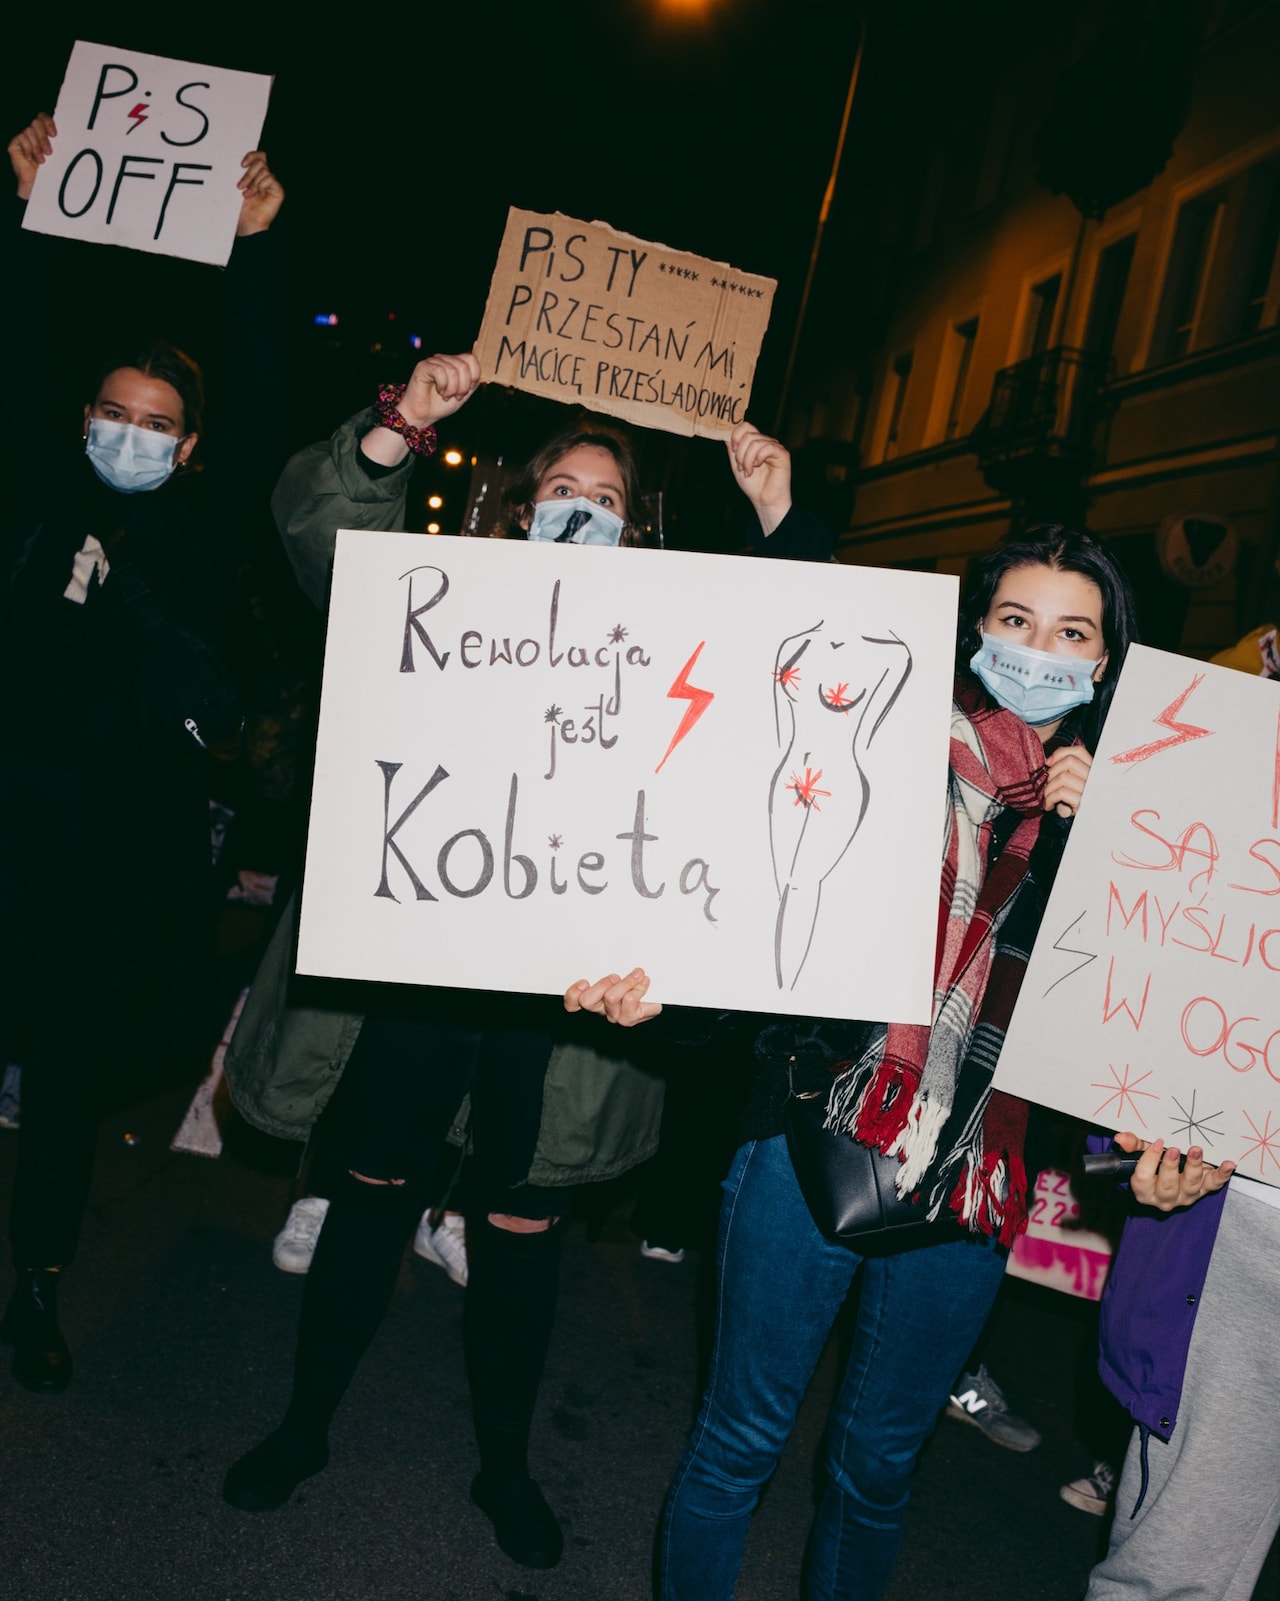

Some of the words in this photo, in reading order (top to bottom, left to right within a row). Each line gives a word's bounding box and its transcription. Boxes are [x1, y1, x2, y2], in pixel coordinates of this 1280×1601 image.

[58, 148, 213, 240] OFF
[519, 227, 587, 282] PiS
[606, 246, 648, 298] TY
[505, 285, 697, 362] PRZESTAŃ
[595, 361, 746, 425] PRZEŚLADOWAĆ
[543, 693, 620, 780] jest
[373, 759, 721, 925] Kobietą
[1111, 809, 1220, 893] SĄ
[1102, 955, 1152, 1033] W
